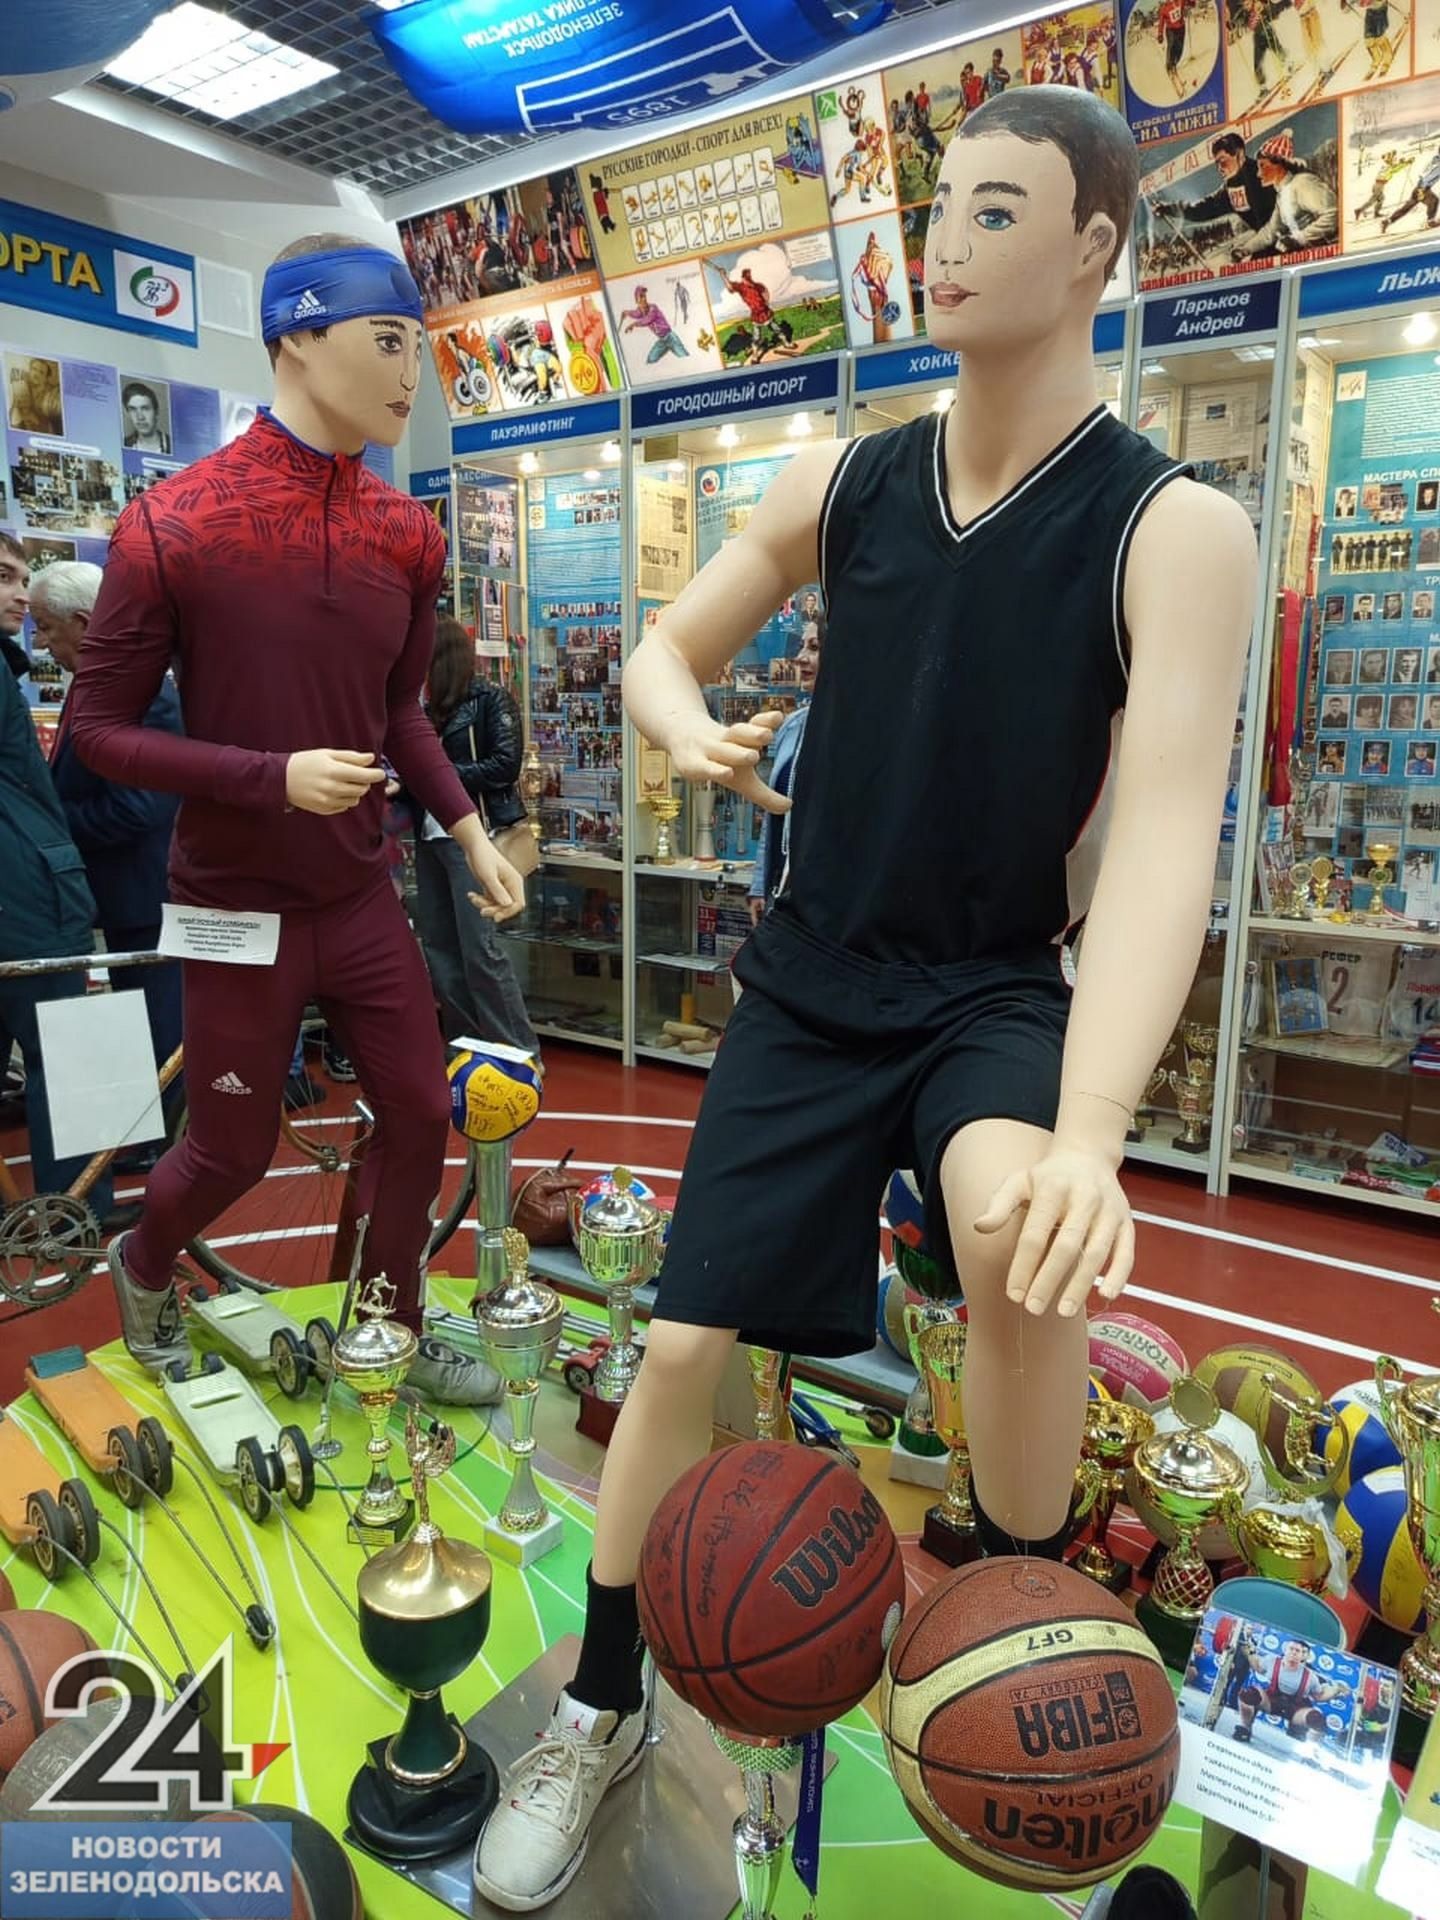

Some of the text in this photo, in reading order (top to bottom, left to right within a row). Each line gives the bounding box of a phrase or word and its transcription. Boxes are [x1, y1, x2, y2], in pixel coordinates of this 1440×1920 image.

[503, 2, 625, 59] ЗЕЛЕНОДОЛЬСК
[607, 95, 688, 124] 1895
[1141, 126, 1160, 142] НА
[1169, 110, 1218, 135] ЛЫЖИ!
[602, 155, 645, 180] РУССКИЕ
[645, 145, 691, 168] ГОРОДКИ
[696, 130, 730, 153] СПОРТ
[752, 112, 784, 137] ВСЕХ!
[0, 231, 102, 294] РТА
[294, 305, 328, 320] adidas
[1172, 292, 1251, 317] Ларьков
[1175, 312, 1246, 338] Андрей
[657, 376, 808, 416] ГОРОДОШНЫЙ СПОРТ
[490, 415, 576, 442] ПАУЭРЛИФТИНГ
[1363, 469, 1418, 484] МАСТЕРА
[1327, 966, 1350, 1015] 2
[211, 1082, 253, 1095] adidas
[1098, 1325, 1169, 1370] TORRES
[1025, 1629, 1074, 1651] GF7
[1039, 1674, 1103, 1697] CATEGORY
[1013, 1690, 1118, 1758] FIBA
[1037, 1774, 1154, 1808] OFFICIAL
[983, 1768, 1176, 1860] molten
